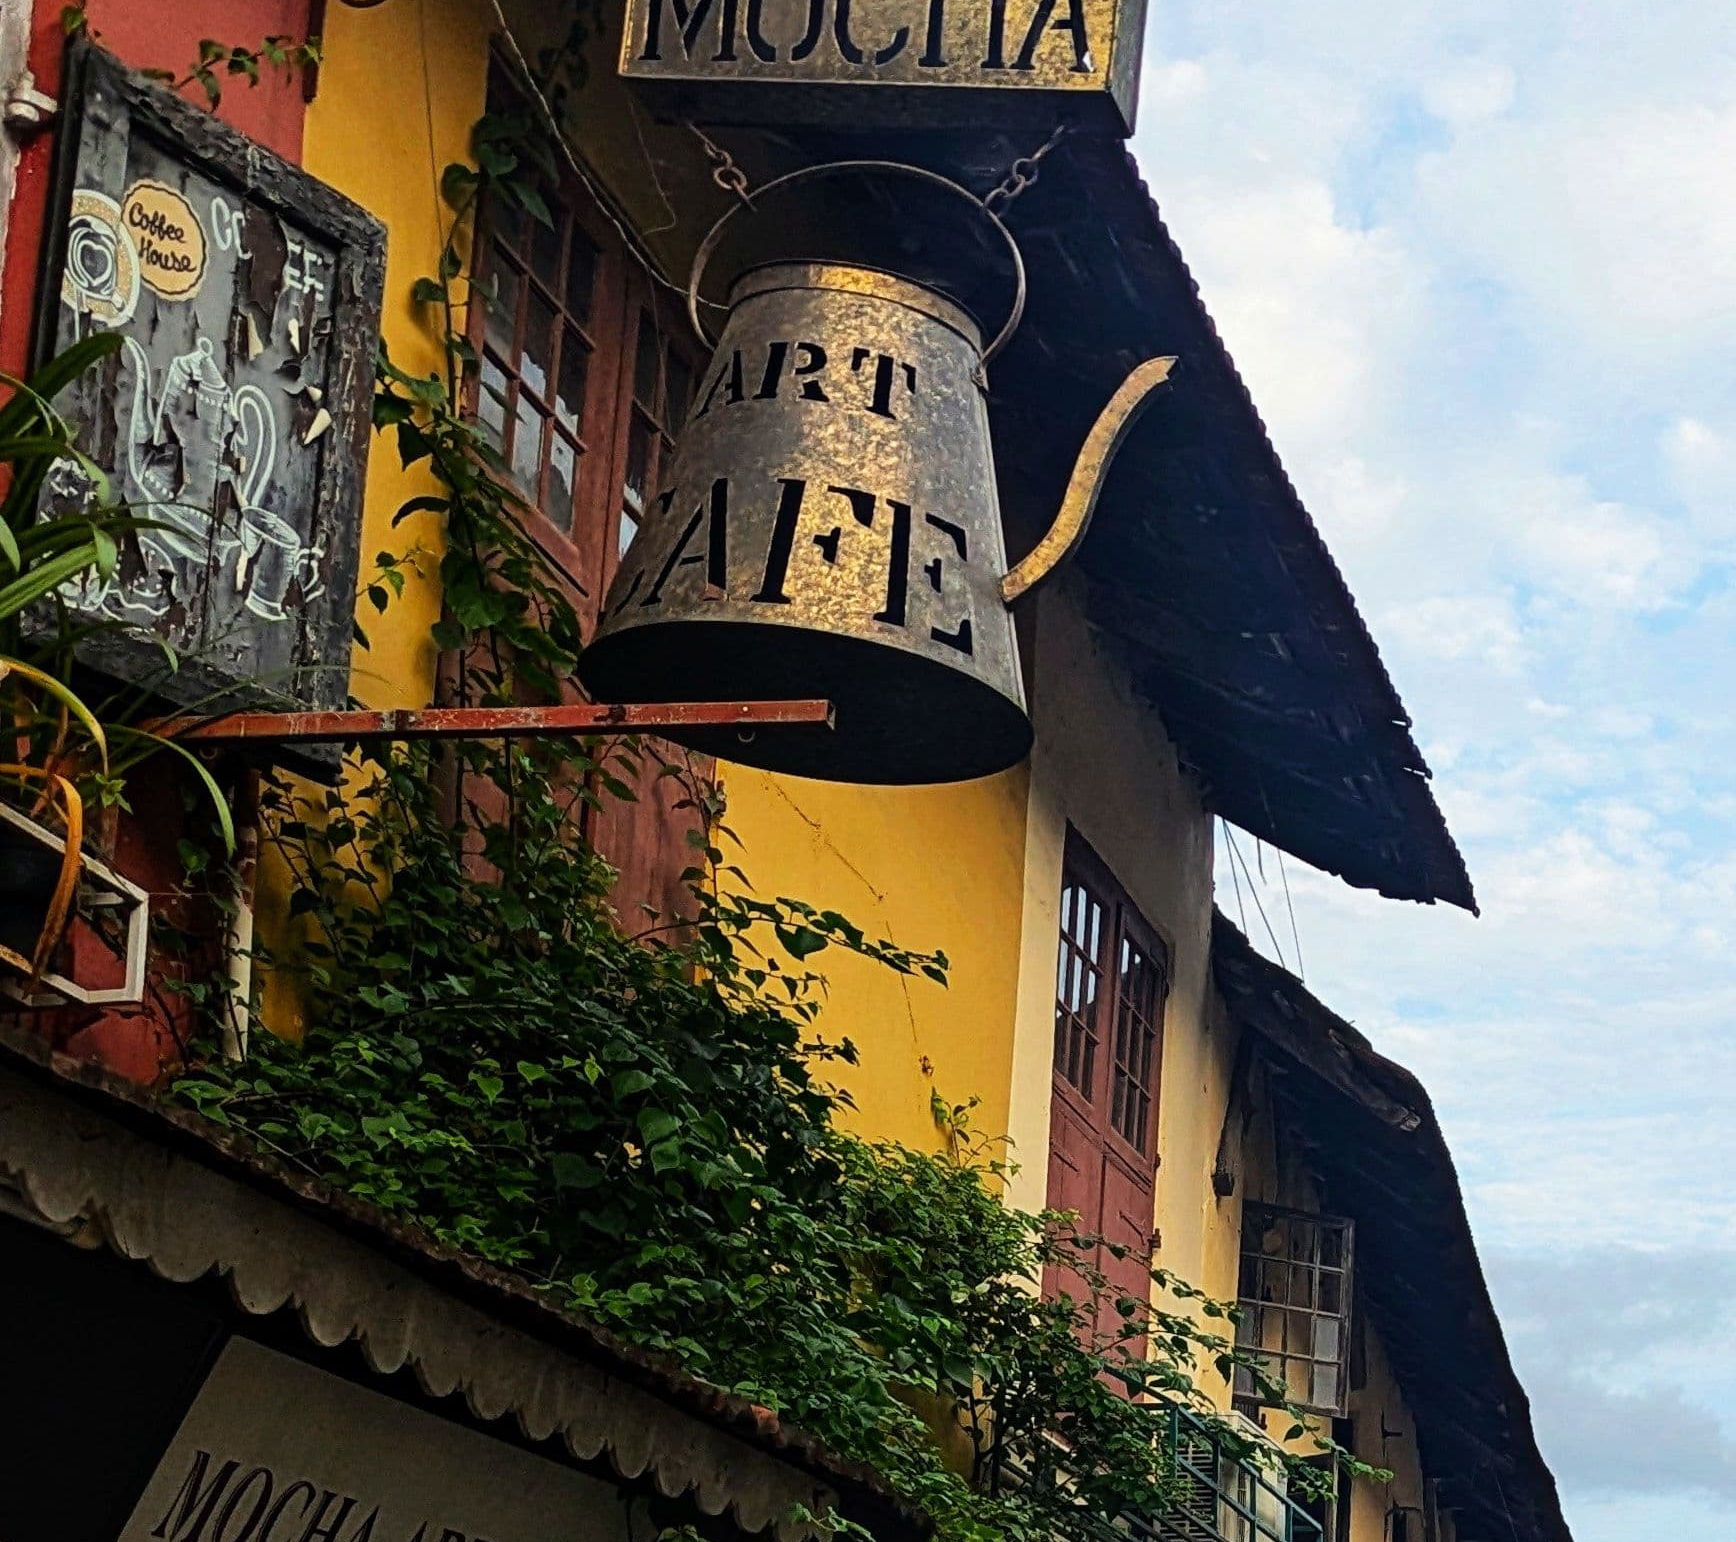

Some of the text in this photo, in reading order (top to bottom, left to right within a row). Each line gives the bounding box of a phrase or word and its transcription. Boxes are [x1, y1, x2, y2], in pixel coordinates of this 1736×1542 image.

[129, 202, 186, 243] Coffee
[139, 237, 196, 272] House
[696, 341, 917, 421] ART
